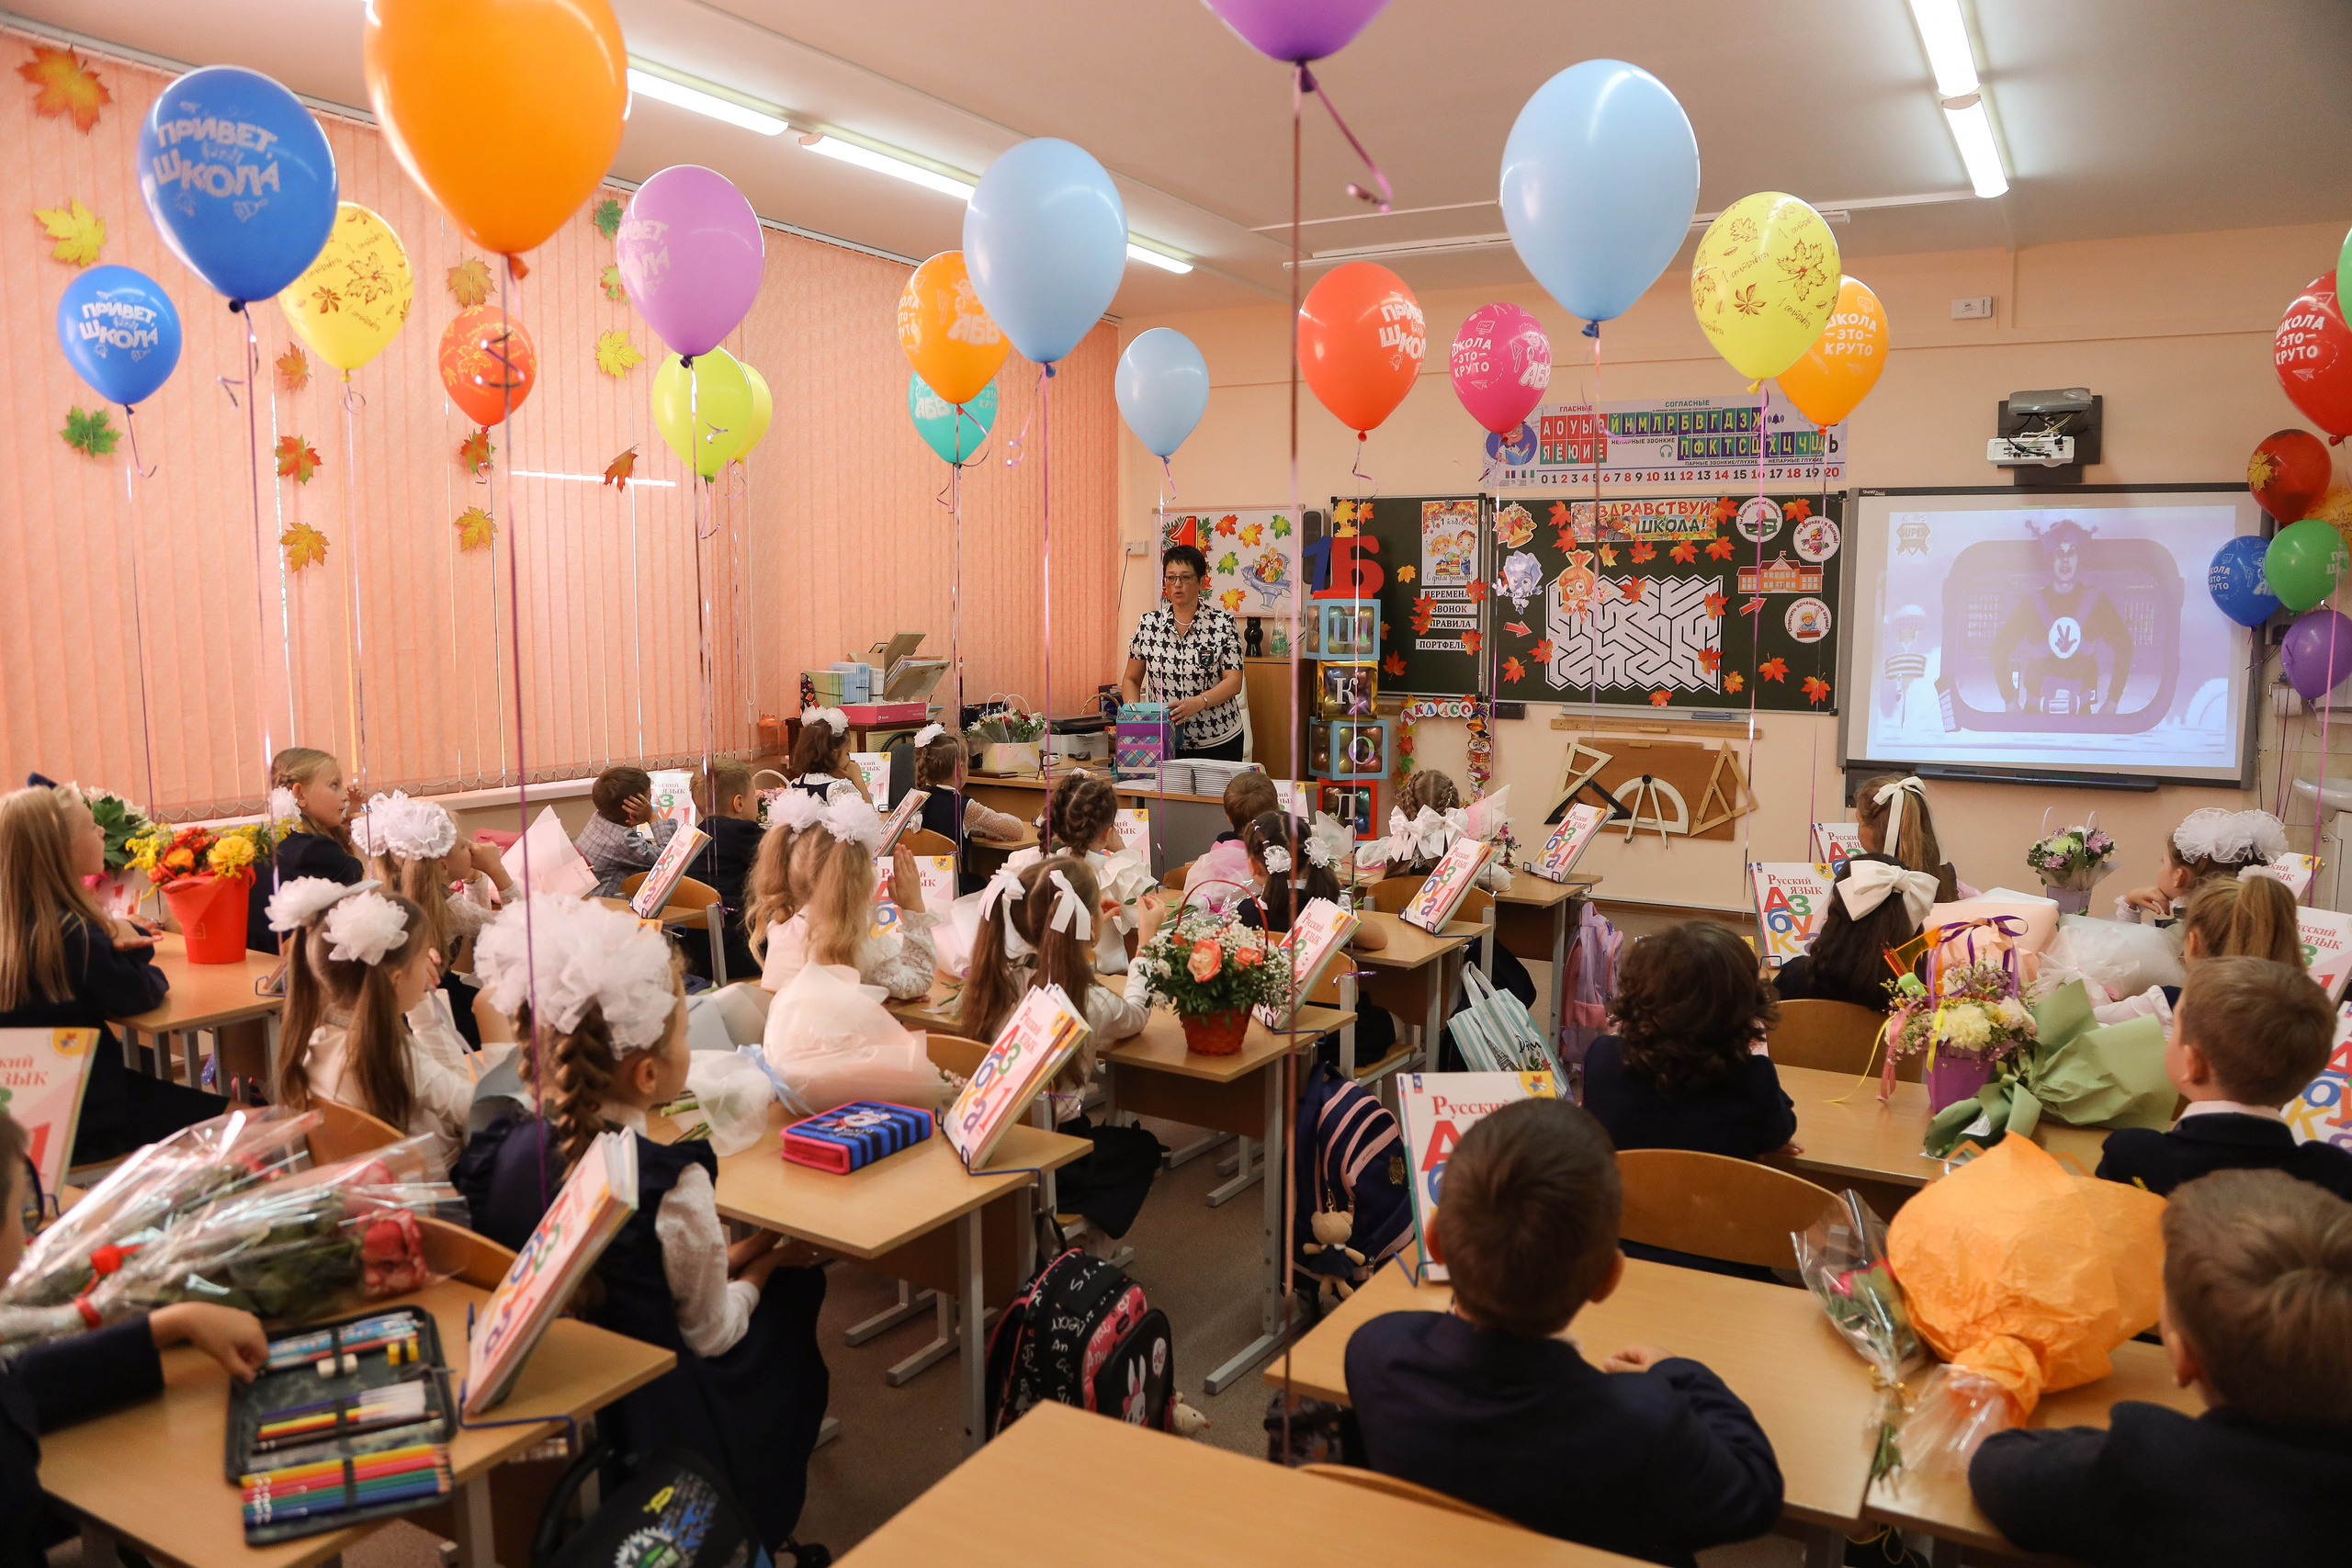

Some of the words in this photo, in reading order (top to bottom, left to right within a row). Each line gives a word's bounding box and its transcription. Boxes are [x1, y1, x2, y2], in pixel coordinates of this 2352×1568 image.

[153, 148, 280, 197] ШКОЛА
[81, 301, 158, 327] ПРИВЕТ,
[79, 319, 159, 349] ШКОЛА
[946, 313, 1001, 345] АБВ
[2276, 314, 2325, 340] ШКОЛА
[1451, 337, 1492, 358] ШКОЛА
[1825, 342, 1873, 356] КРУТО
[2275, 345, 2318, 365] КРУТО
[1453, 361, 1490, 378] КРУТО
[1519, 361, 1552, 389] АБВ
[1542, 475, 1548, 483] 0
[1552, 475, 1557, 483] 1
[1561, 474, 1567, 483] 2
[1571, 474, 1577, 483] 3
[1582, 474, 1589, 482] 4
[1603, 473, 1610, 482] 6
[1614, 473, 1621, 481] 7
[1624, 473, 1632, 481] 8
[1635, 472, 1643, 481] 9
[1646, 472, 1659, 481] 10
[1664, 471, 1676, 480] 11
[1680, 471, 1693, 480] 12
[1698, 470, 1711, 479] 13
[1715, 470, 1729, 479] 14
[1734, 469, 1747, 479] 15
[1770, 468, 1783, 479] 17
[1787, 468, 1801, 478] 18
[1805, 468, 1819, 478] 19
[1826, 468, 1839, 477] 20
[1599, 500, 1712, 517] ЗДРАВСТВУЙ
[2210, 566, 2231, 575] КОЛА
[2210, 582, 2230, 592] РУТО
[1333, 677, 1359, 705] К
[1827, 832, 1859, 841] Русски
[1768, 874, 1812, 886] Русский
[2297, 926, 2337, 938] усский
